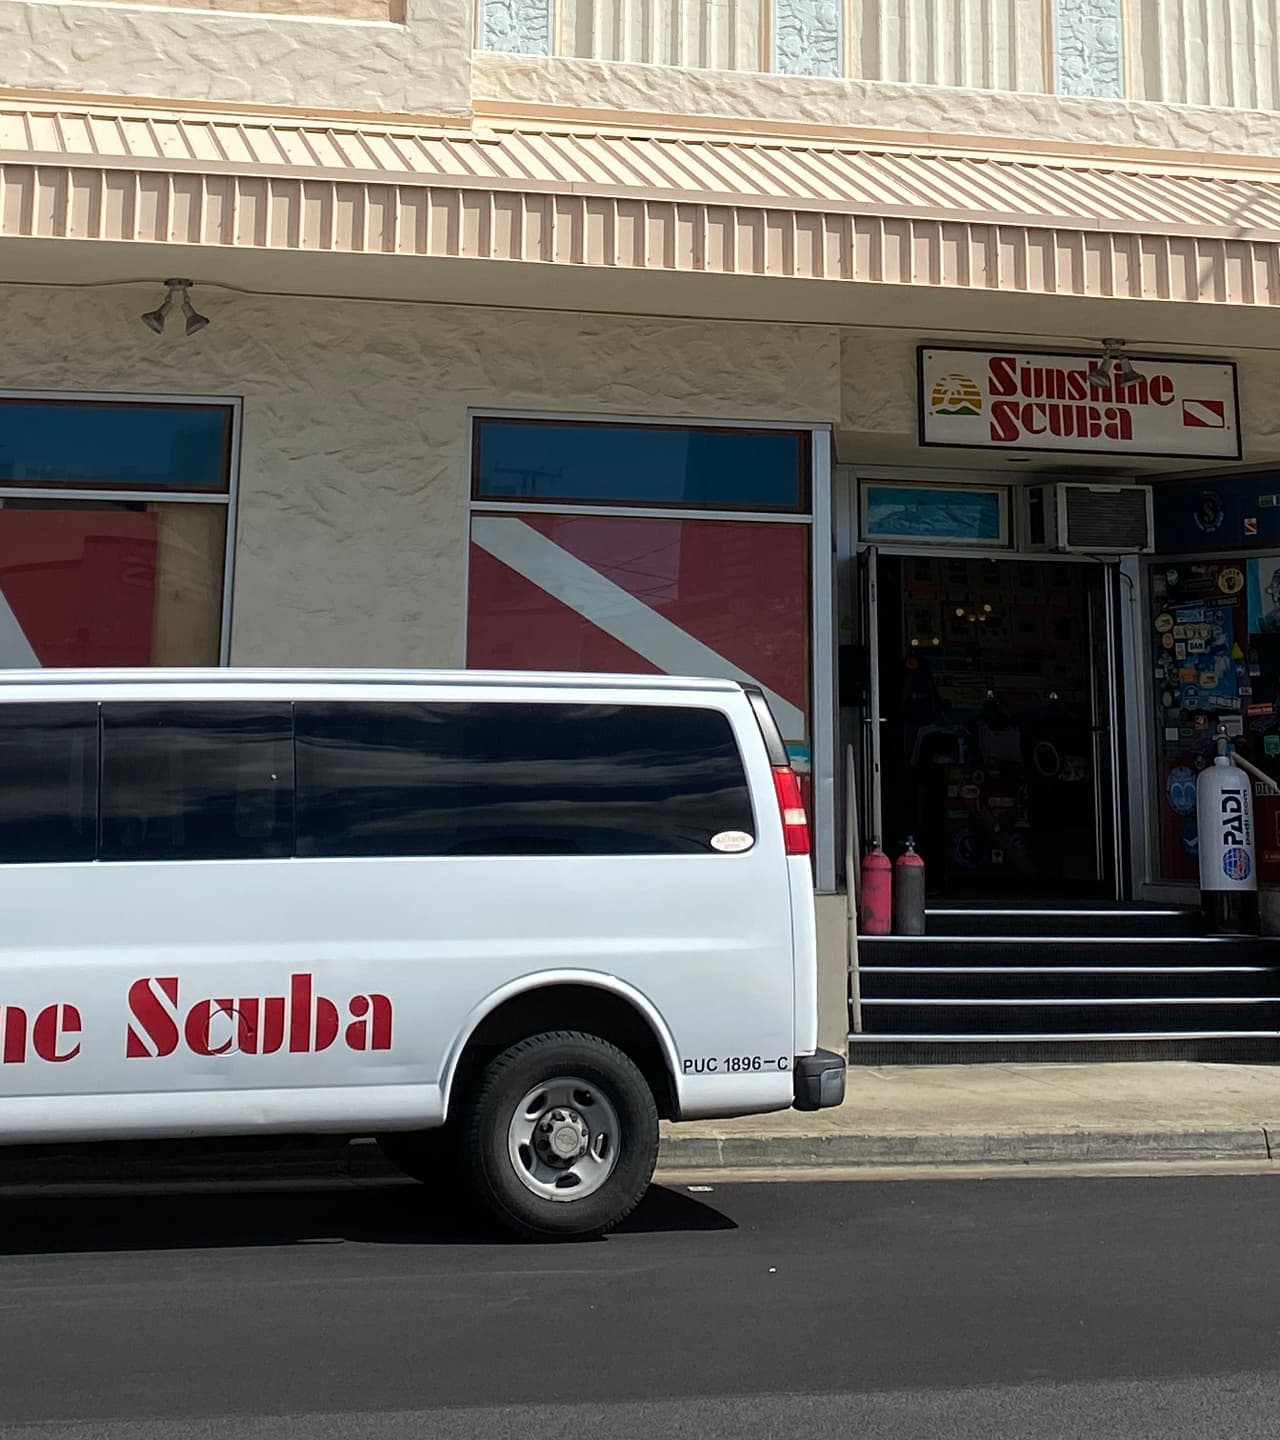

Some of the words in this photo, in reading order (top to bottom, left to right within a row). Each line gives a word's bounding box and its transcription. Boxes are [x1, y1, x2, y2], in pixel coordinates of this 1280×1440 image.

[988, 357, 1175, 407] Sunshine
[1221, 789, 1244, 846] PADI
[125, 972, 393, 1060] Scuba
[683, 1058, 718, 1074] PUC
[723, 1056, 788, 1072] 1896-C
